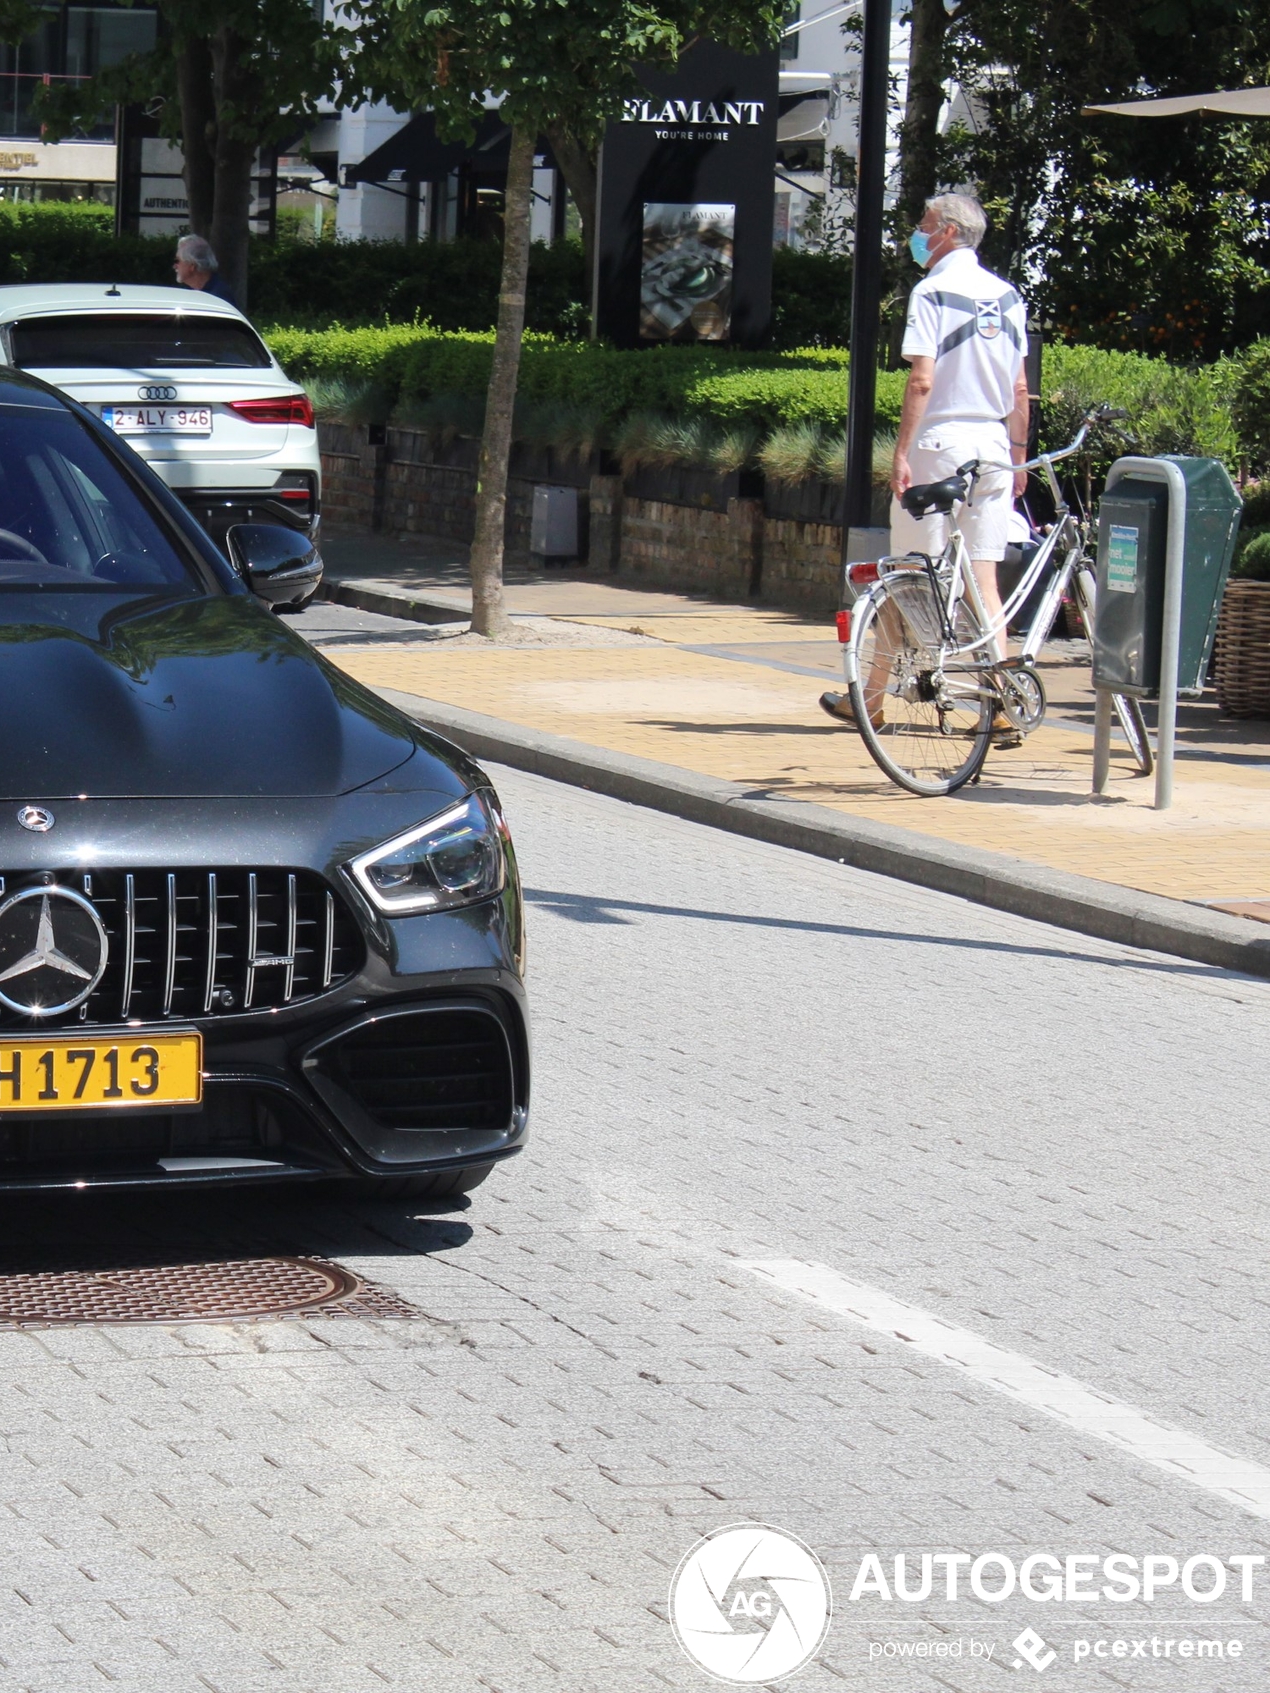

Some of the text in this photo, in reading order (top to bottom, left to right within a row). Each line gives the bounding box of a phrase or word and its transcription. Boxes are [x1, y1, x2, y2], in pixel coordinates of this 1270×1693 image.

[621, 99, 764, 125] FLAMANT
[655, 130, 729, 141] YOU'RE HOME
[682, 211, 729, 221] FLAMANT
